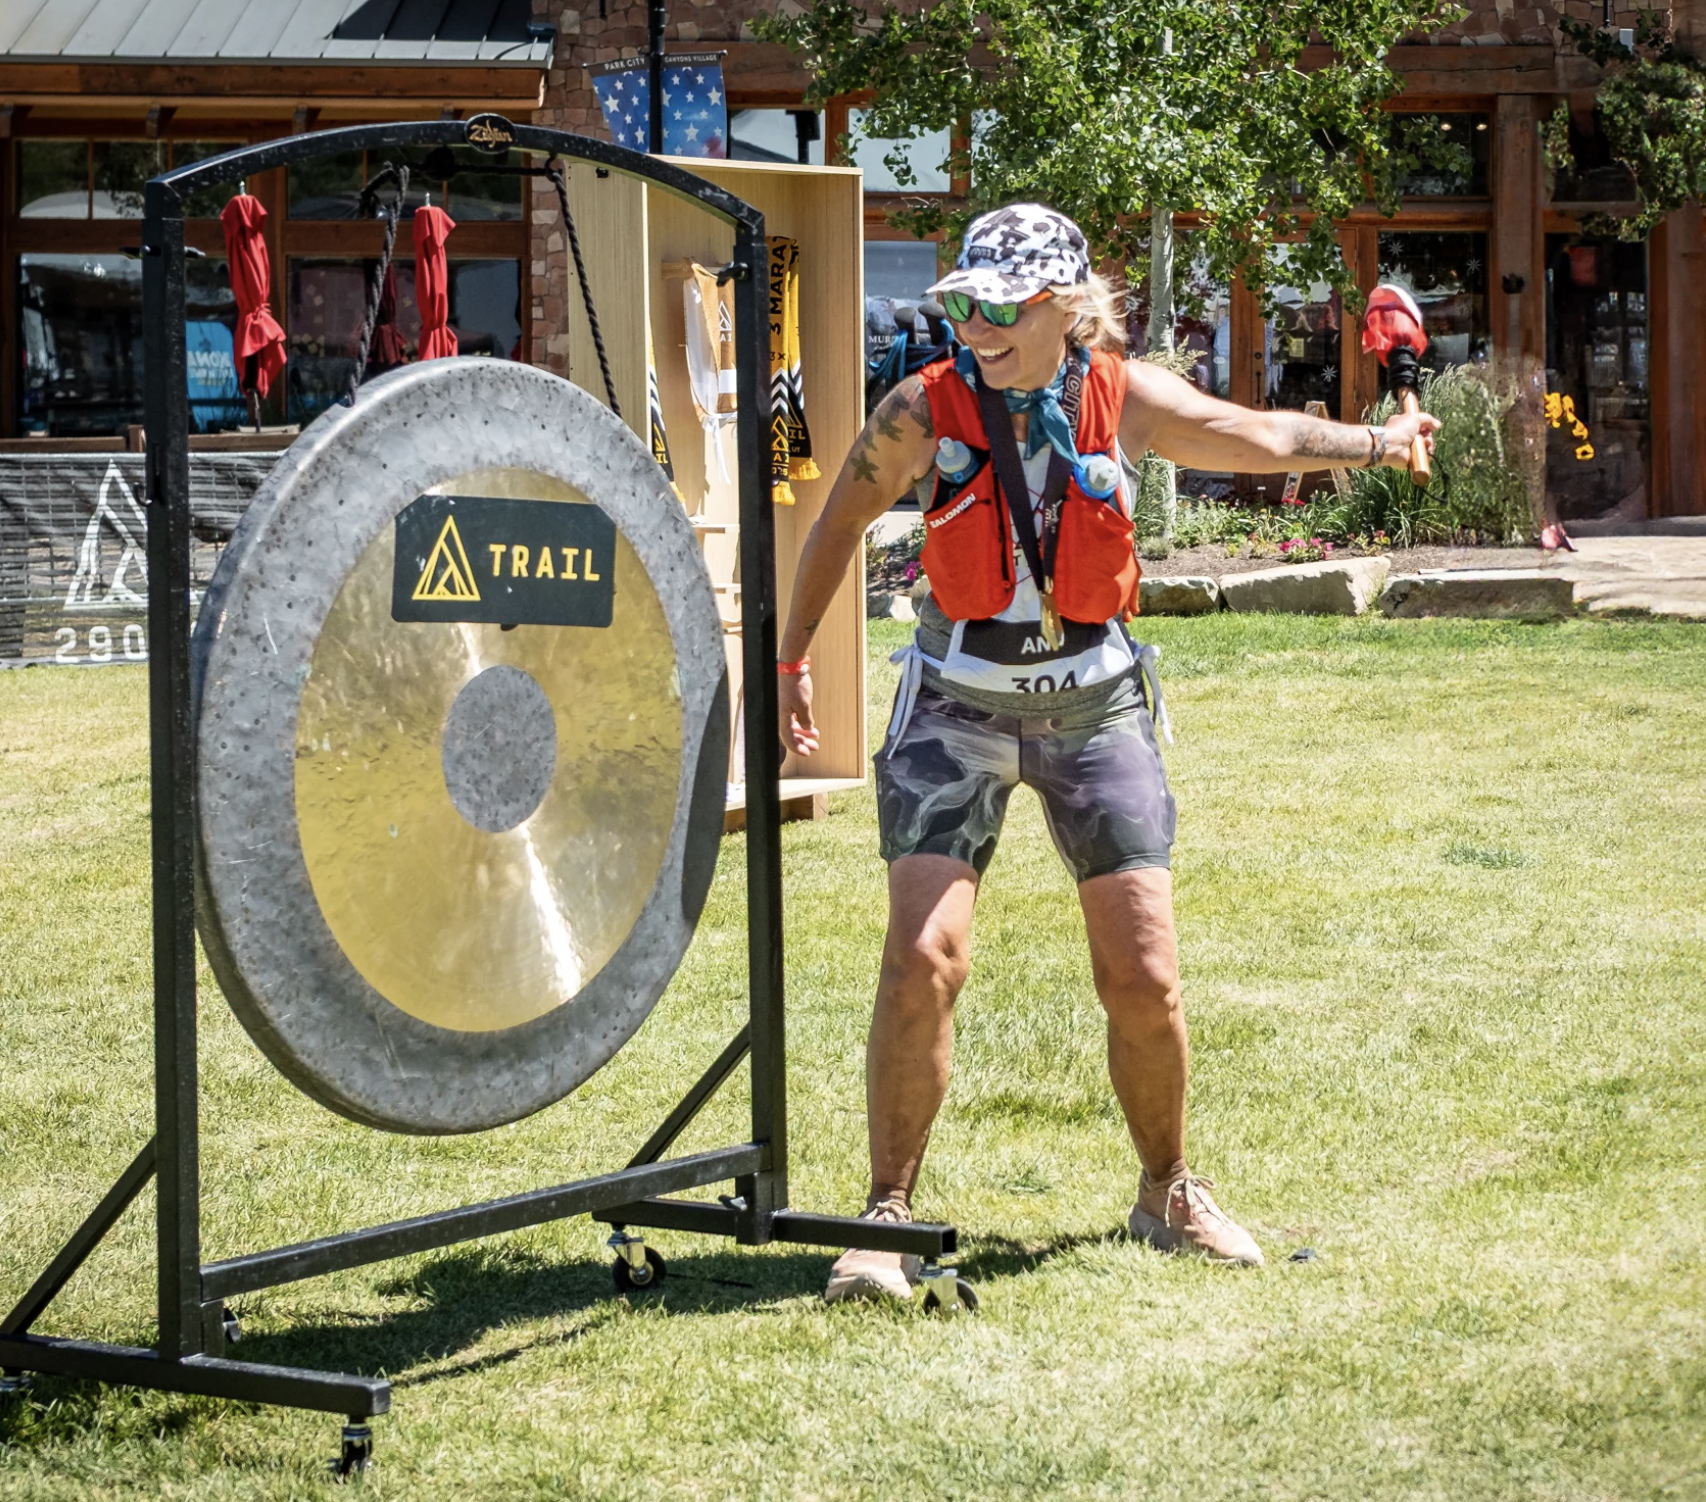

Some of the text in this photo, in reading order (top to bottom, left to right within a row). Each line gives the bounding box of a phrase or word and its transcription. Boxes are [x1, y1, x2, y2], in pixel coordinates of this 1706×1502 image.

[604, 57, 646, 70] PARK CITY
[664, 55, 692, 63] CANYONS
[929, 492, 976, 529] SALOMON
[488, 543, 600, 581] TRAIL
[1011, 669, 1080, 694] 304
